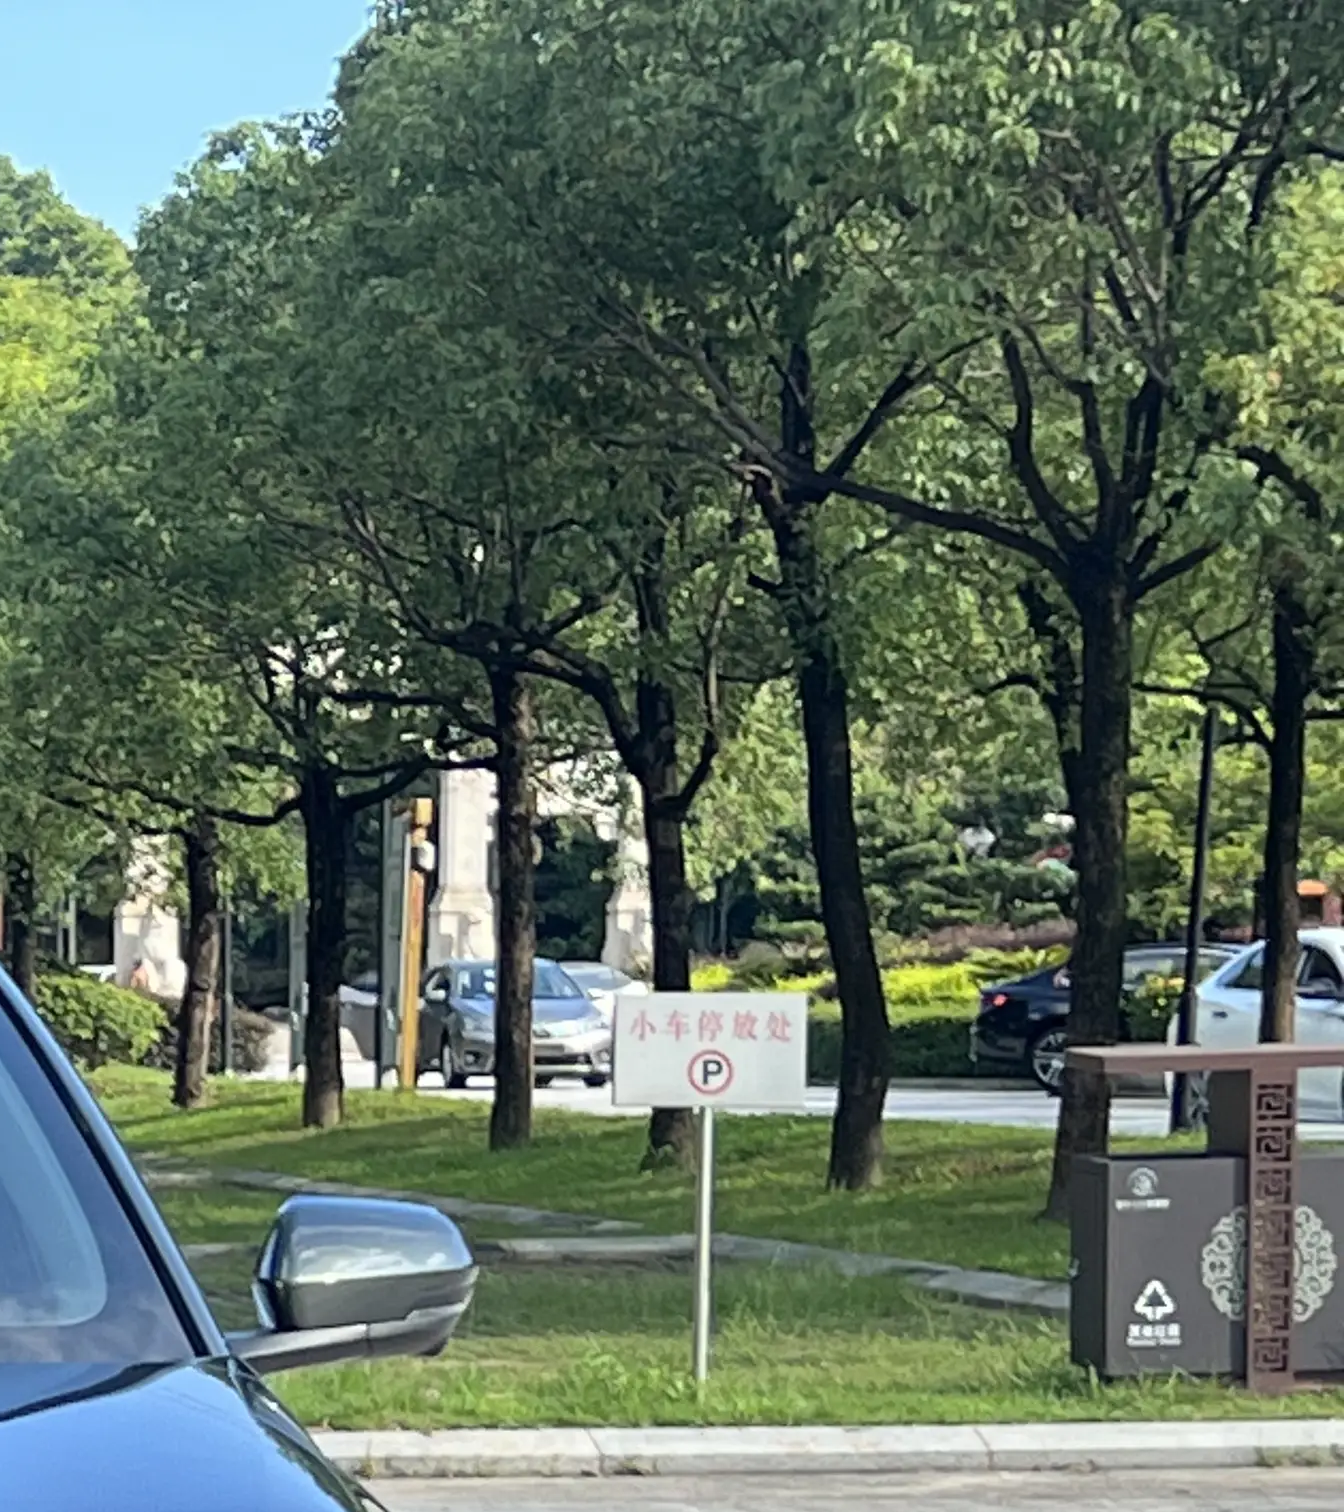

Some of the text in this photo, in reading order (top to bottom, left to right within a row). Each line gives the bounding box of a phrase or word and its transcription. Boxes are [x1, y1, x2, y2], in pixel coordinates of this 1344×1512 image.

[629, 1008, 792, 1043] 小车停放处
[701, 1059, 724, 1085] P
